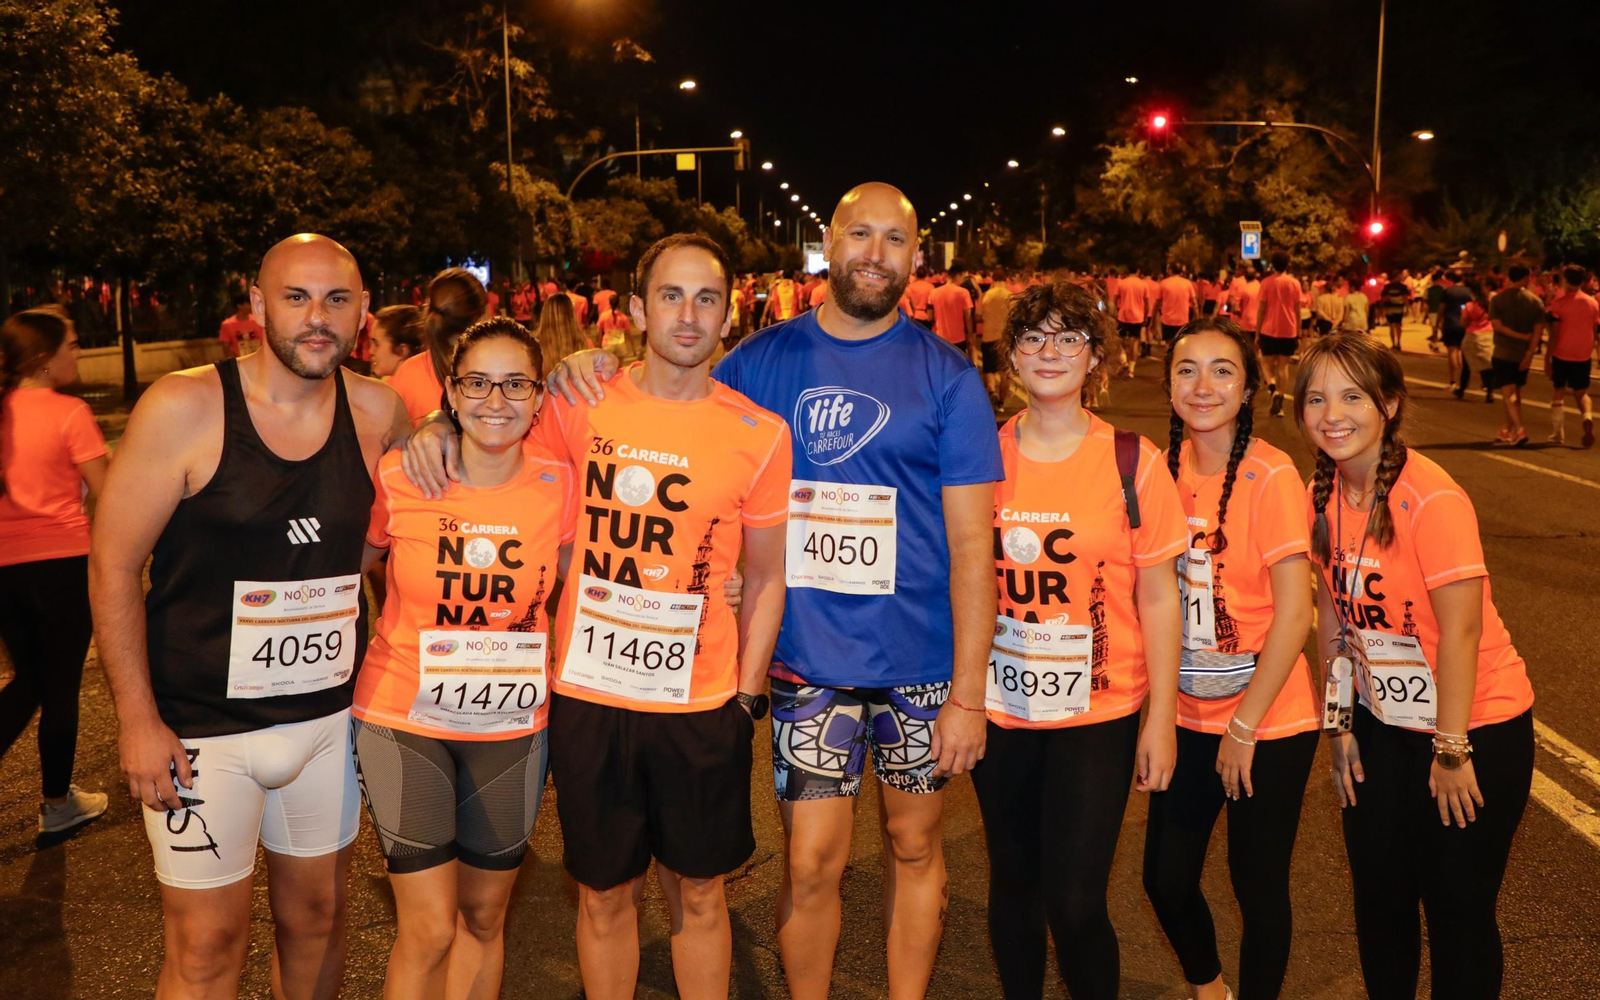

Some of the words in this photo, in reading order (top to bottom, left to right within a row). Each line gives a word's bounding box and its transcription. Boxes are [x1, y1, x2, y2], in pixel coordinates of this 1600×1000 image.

[808, 395, 854, 434] life
[591, 436, 614, 456] 36
[617, 444, 689, 468] CARRERA
[808, 433, 854, 455] CARREFOUR
[439, 518, 458, 531] 36
[461, 522, 518, 534] CARRERA
[585, 505, 674, 556] TUR
[1001, 508, 1070, 522] CARRERA
[804, 532, 878, 566] 4050
[583, 549, 643, 589] NA
[436, 570, 515, 603] TUR
[436, 603, 489, 626] NA
[252, 630, 342, 668] 4059
[583, 625, 685, 671] 11468
[615, 665, 635, 673] SALAZAR
[989, 660, 1082, 697] 18937
[431, 682, 538, 709] 11470
